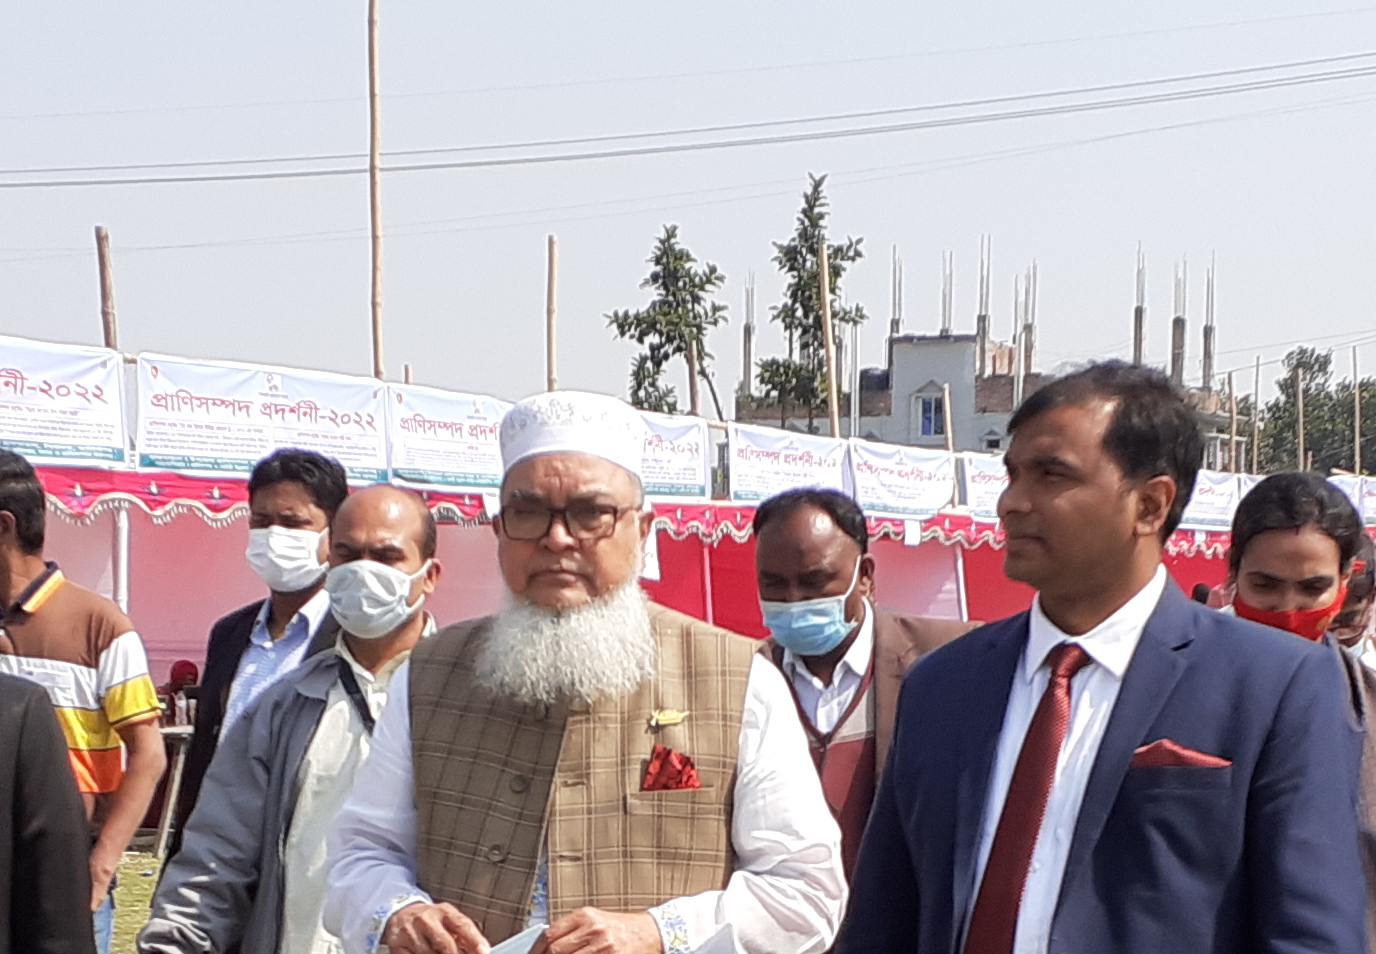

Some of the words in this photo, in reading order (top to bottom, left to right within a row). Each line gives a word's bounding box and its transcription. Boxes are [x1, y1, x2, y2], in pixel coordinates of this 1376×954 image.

[150, 389, 253, 418] প্রাণিসম্পদ
[259, 400, 377, 432] প্রদর্শনী-২০২২
[400, 413, 464, 438] প্রাণিসম্পদ
